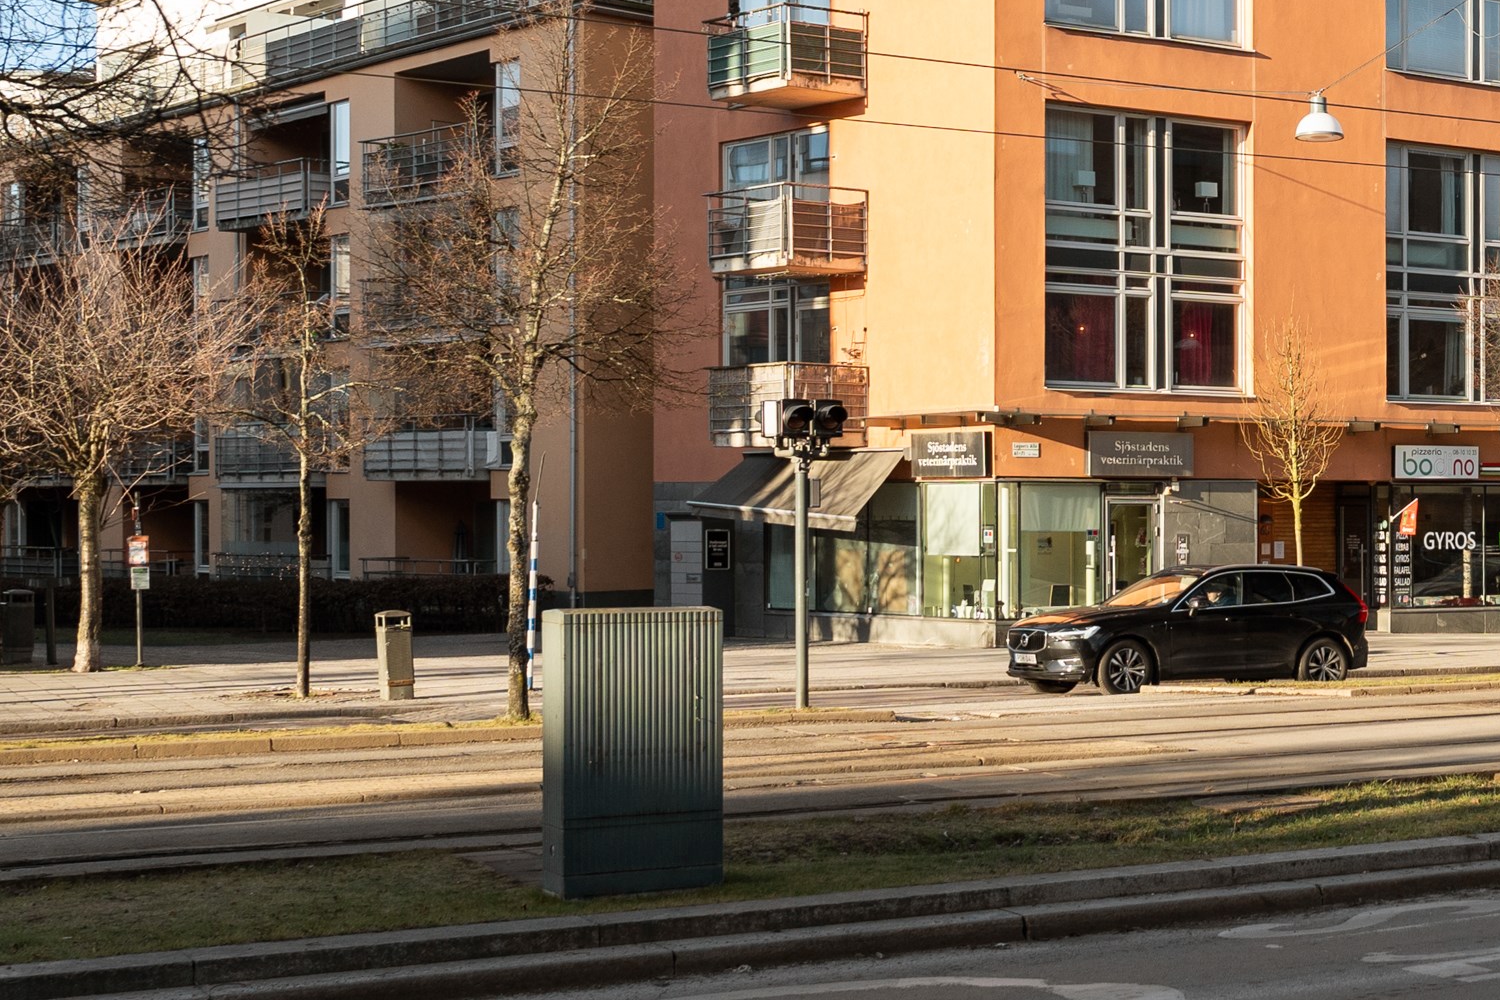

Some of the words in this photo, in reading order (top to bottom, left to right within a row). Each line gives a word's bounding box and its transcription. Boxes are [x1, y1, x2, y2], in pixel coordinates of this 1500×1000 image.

[927, 441, 967, 455] Sjöstadens
[1114, 440, 1170, 454] Sjöstadens
[1411, 448, 1442, 457] pizzeria
[918, 455, 977, 469] veterinärpraktik
[1101, 454, 1184, 469] veterinärpraktik
[1423, 531, 1477, 550] GYROS
[1395, 577, 1411, 587] SALLAD
